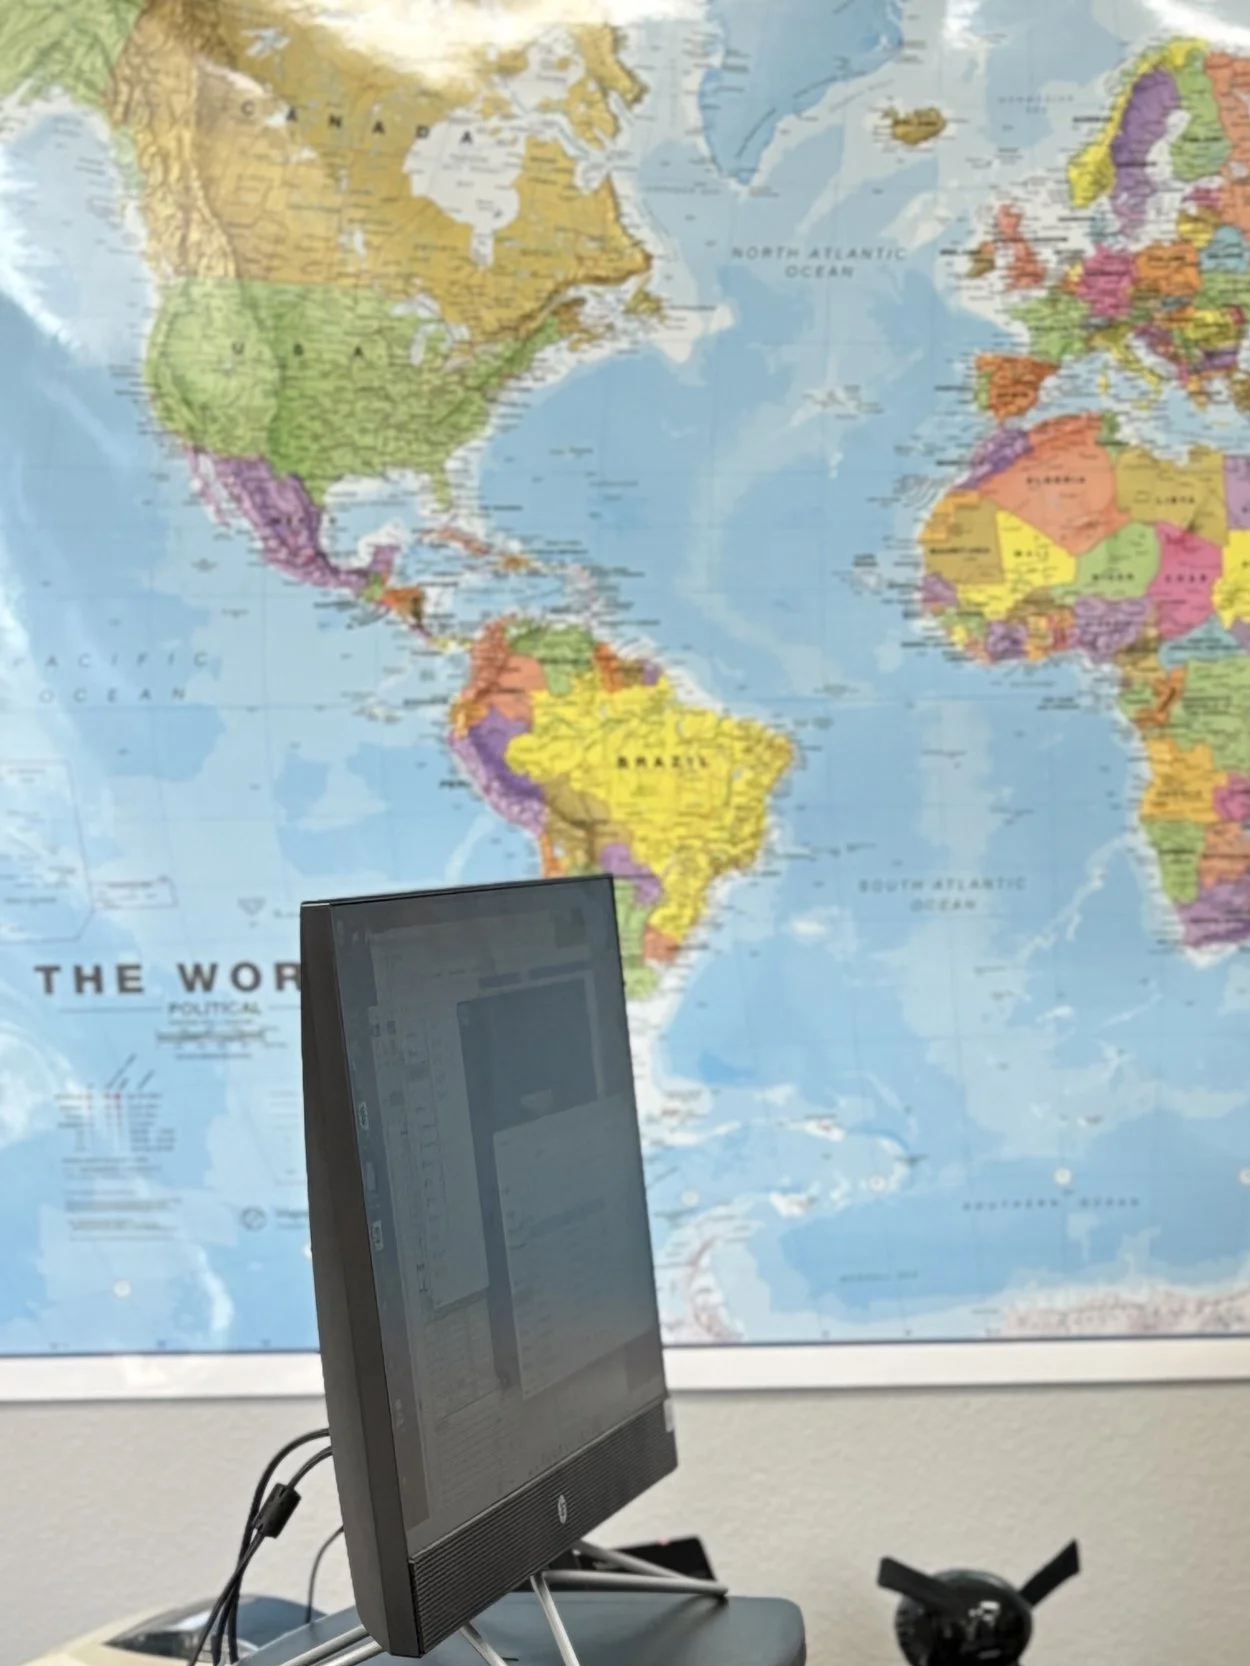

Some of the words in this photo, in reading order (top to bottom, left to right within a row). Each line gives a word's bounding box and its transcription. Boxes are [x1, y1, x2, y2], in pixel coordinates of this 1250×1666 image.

[241, 101, 474, 144] CANADA
[731, 246, 799, 260] NORTH
[807, 246, 907, 260] ATLANTIC
[784, 264, 855, 279] OCEAN
[38, 686, 186, 704] OCEAN
[617, 755, 708, 769] BRAZIL
[34, 963, 145, 995] THE
[177, 961, 301, 994] WOR
[168, 1002, 261, 1016] POLITICAL
